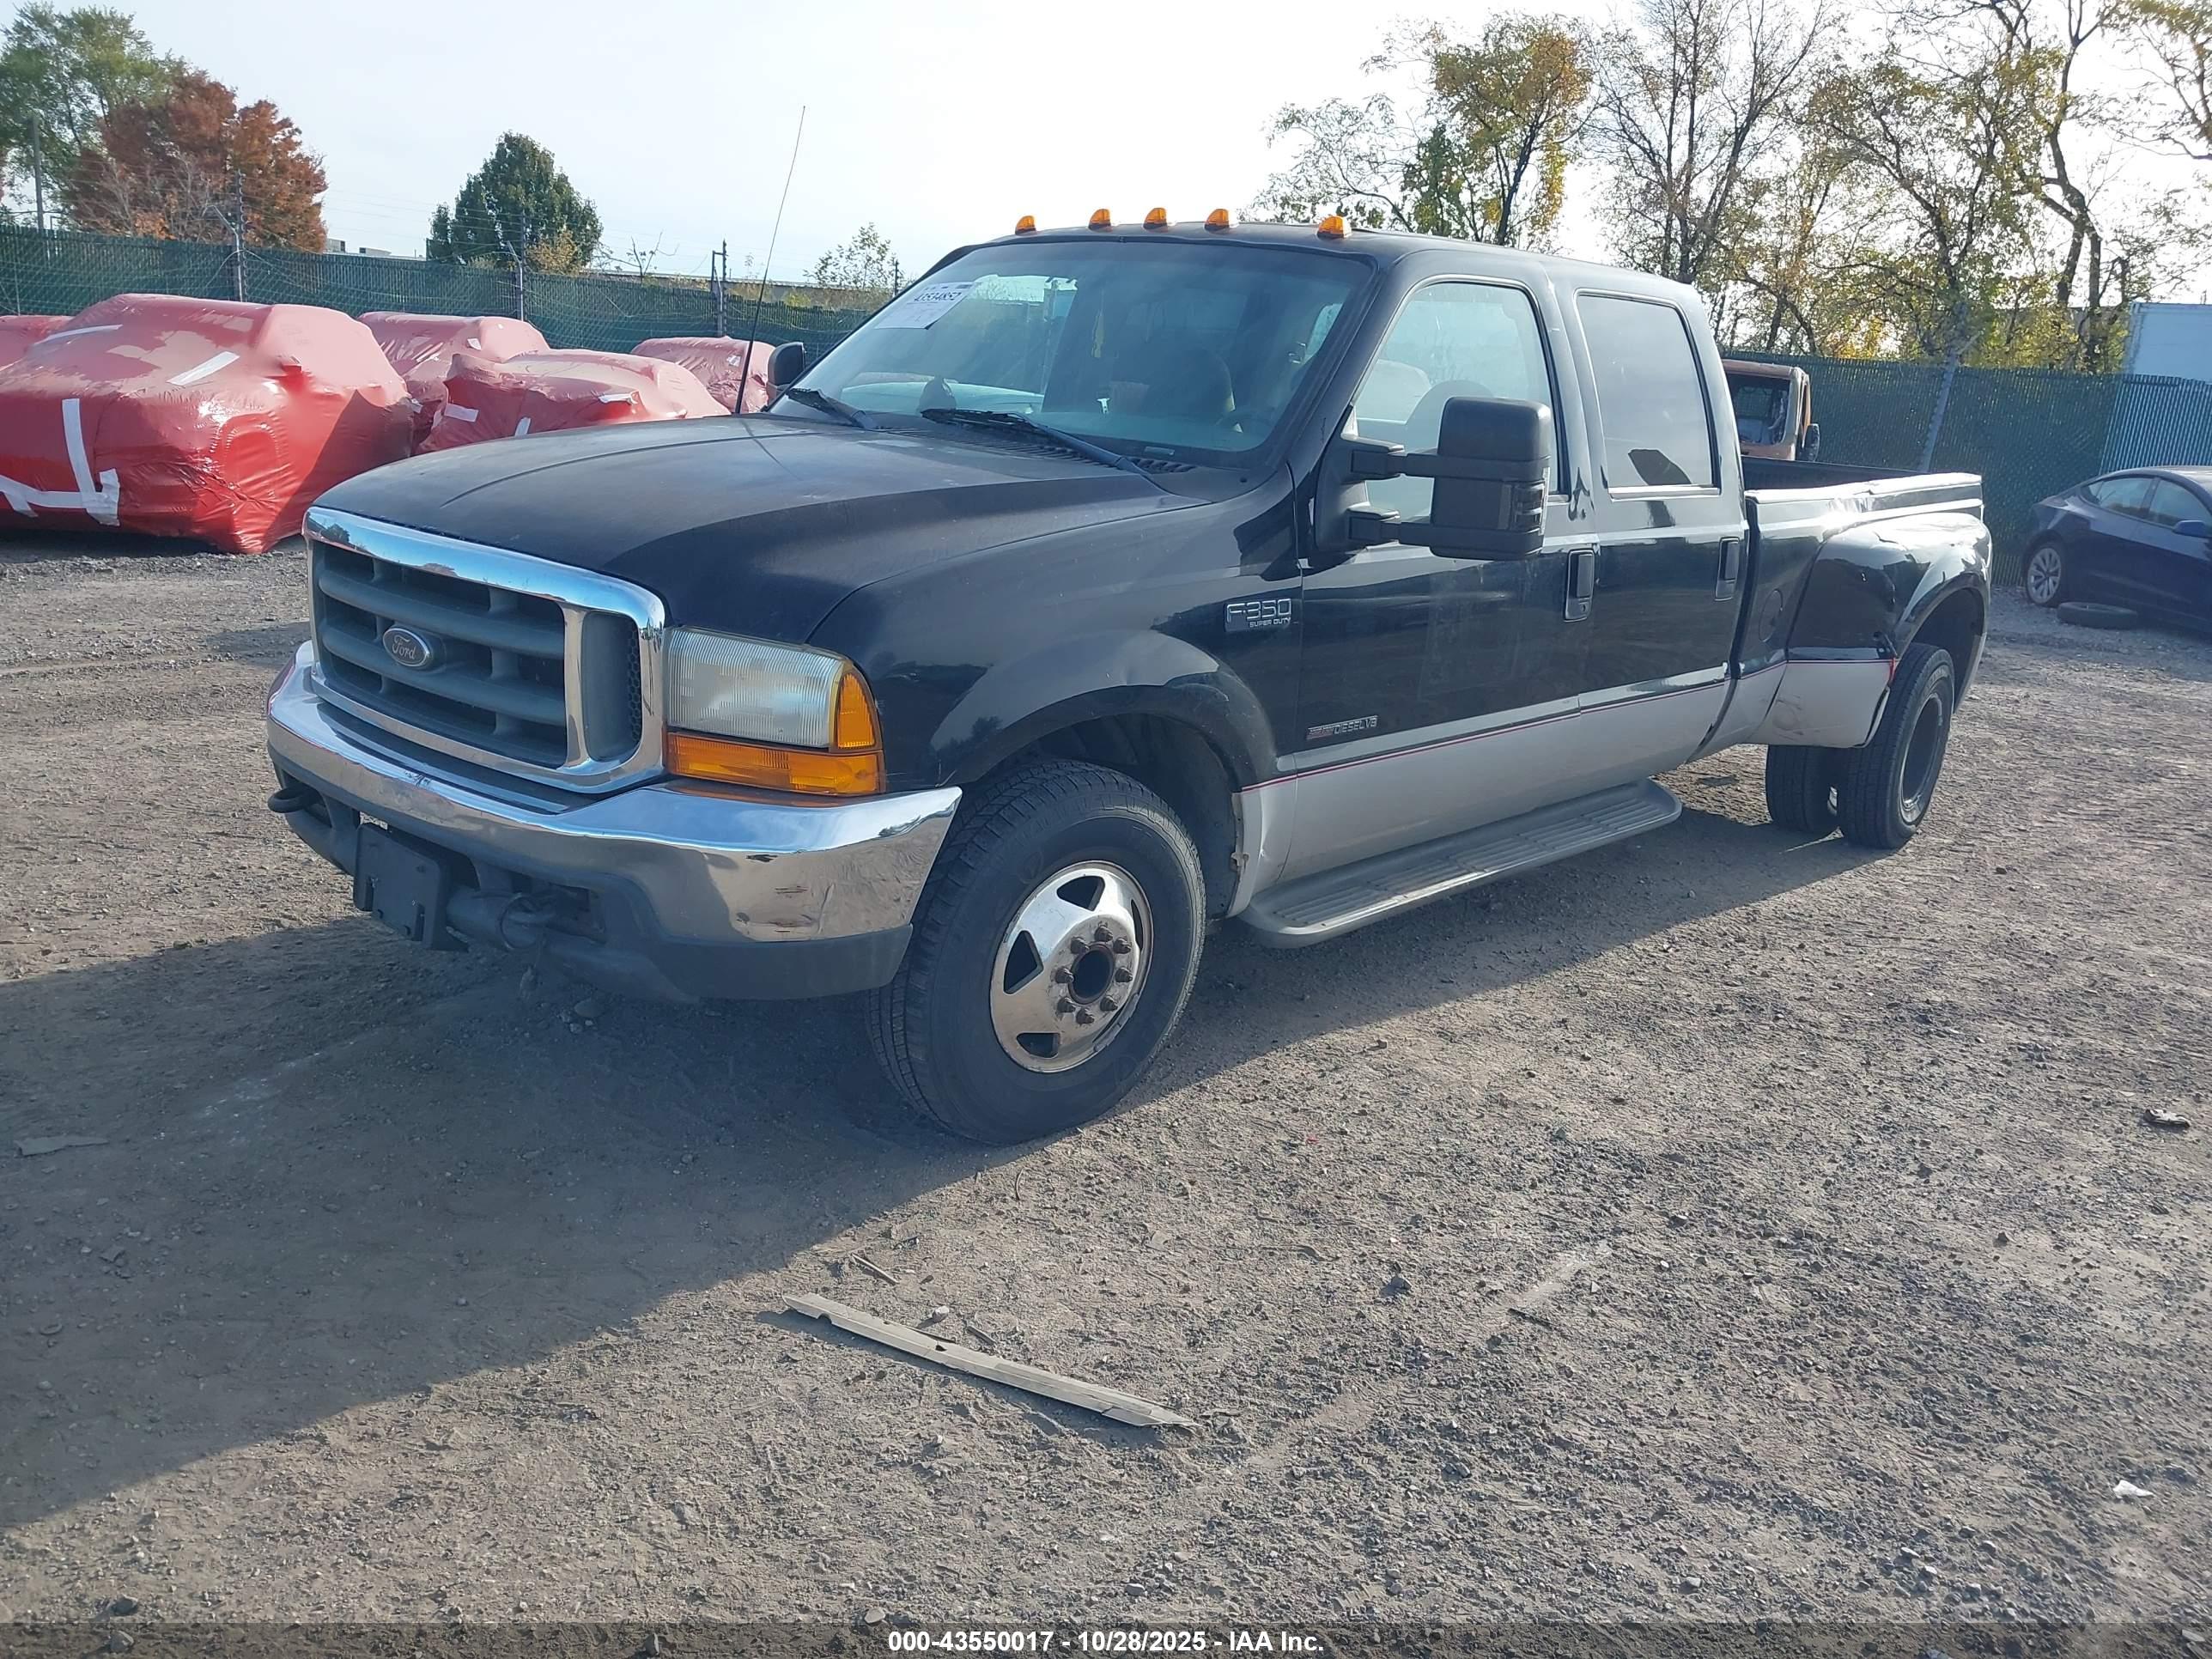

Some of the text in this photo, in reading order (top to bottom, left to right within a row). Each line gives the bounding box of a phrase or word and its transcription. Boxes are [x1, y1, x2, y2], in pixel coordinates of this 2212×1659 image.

[1249, 617, 1291, 628] SUPER DUTY
[392, 634, 417, 660] Ford
[1334, 720, 1364, 735] DIESEL
